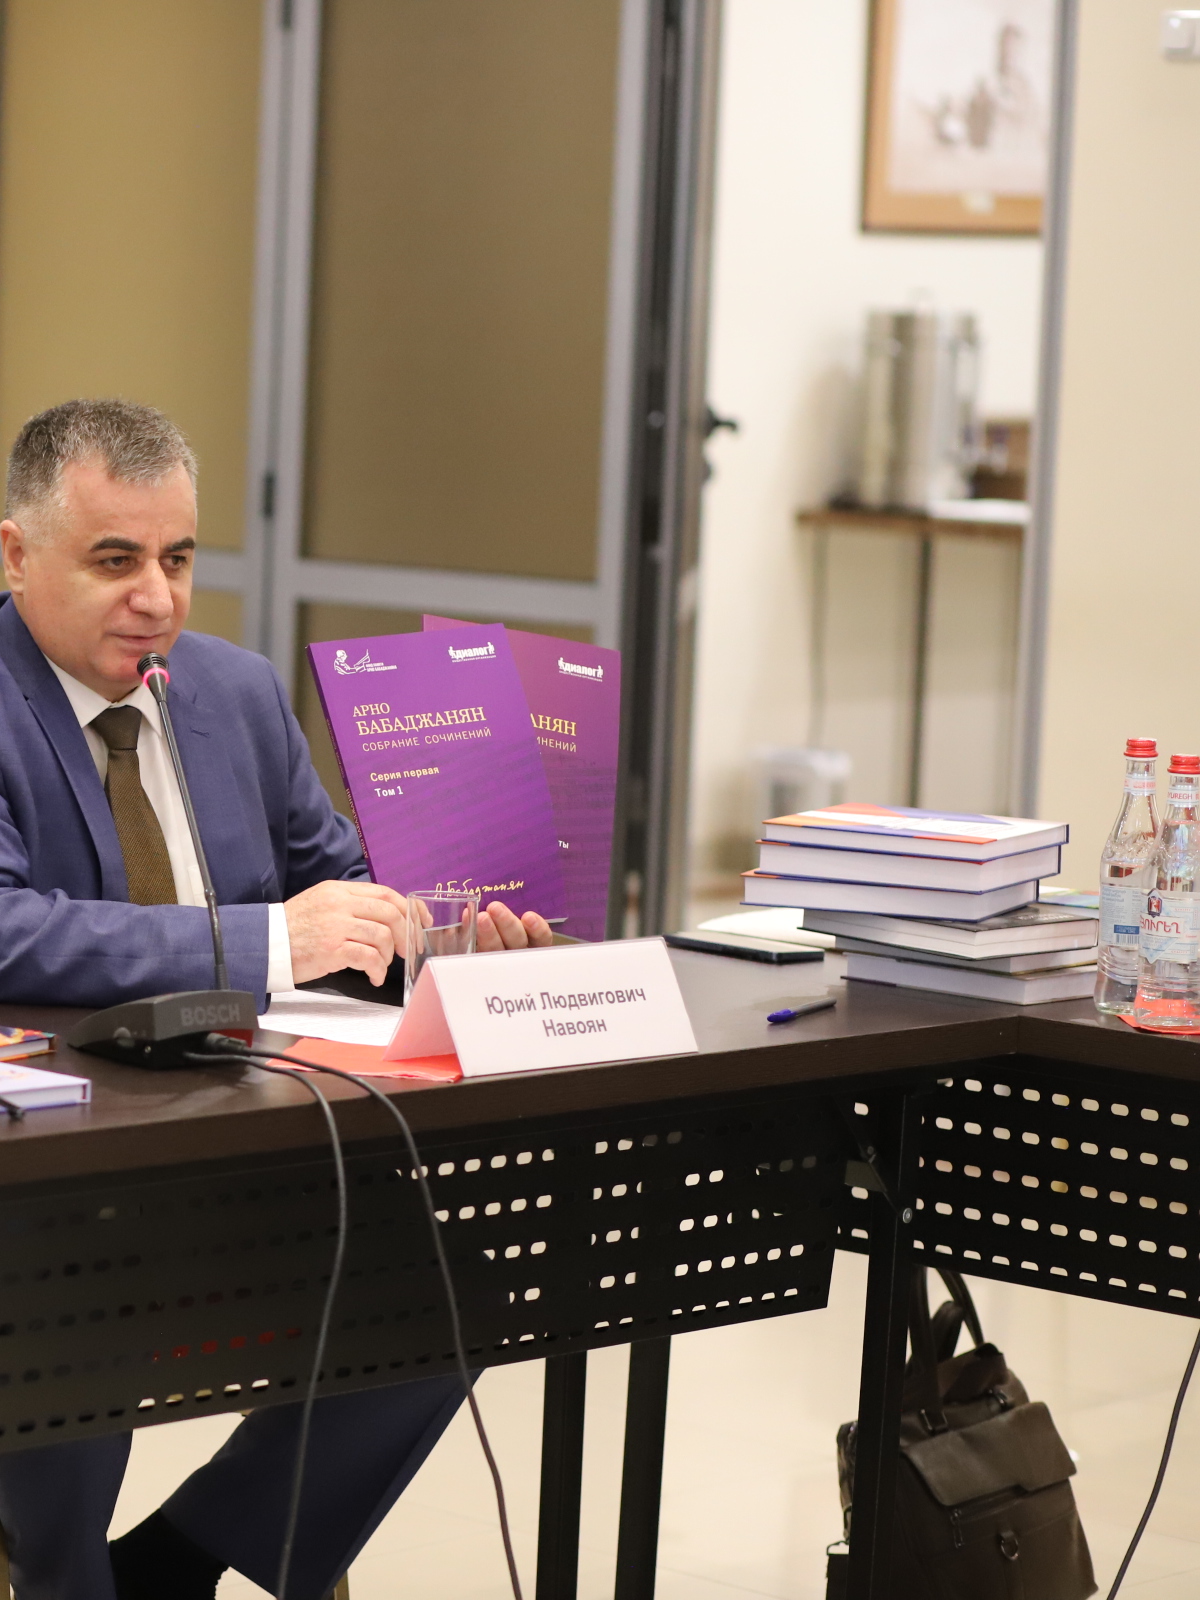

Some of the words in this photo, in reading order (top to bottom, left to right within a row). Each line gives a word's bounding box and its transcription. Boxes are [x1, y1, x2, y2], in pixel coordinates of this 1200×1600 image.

[353, 702, 391, 717] АРНО
[356, 707, 487, 736] БАБАДЖАНЯН
[362, 737, 421, 752] СОБРАНИЕ
[424, 726, 492, 744] СОЧИНЕНИЙ
[370, 771, 402, 782] Серия
[403, 766, 440, 778] первая
[374, 787, 396, 797] Том
[396, 785, 404, 795] 1
[485, 993, 537, 1017] Юрий
[540, 988, 647, 1010] Людвигович
[180, 1003, 241, 1027] BOSCH
[542, 1018, 608, 1037] Навоян
